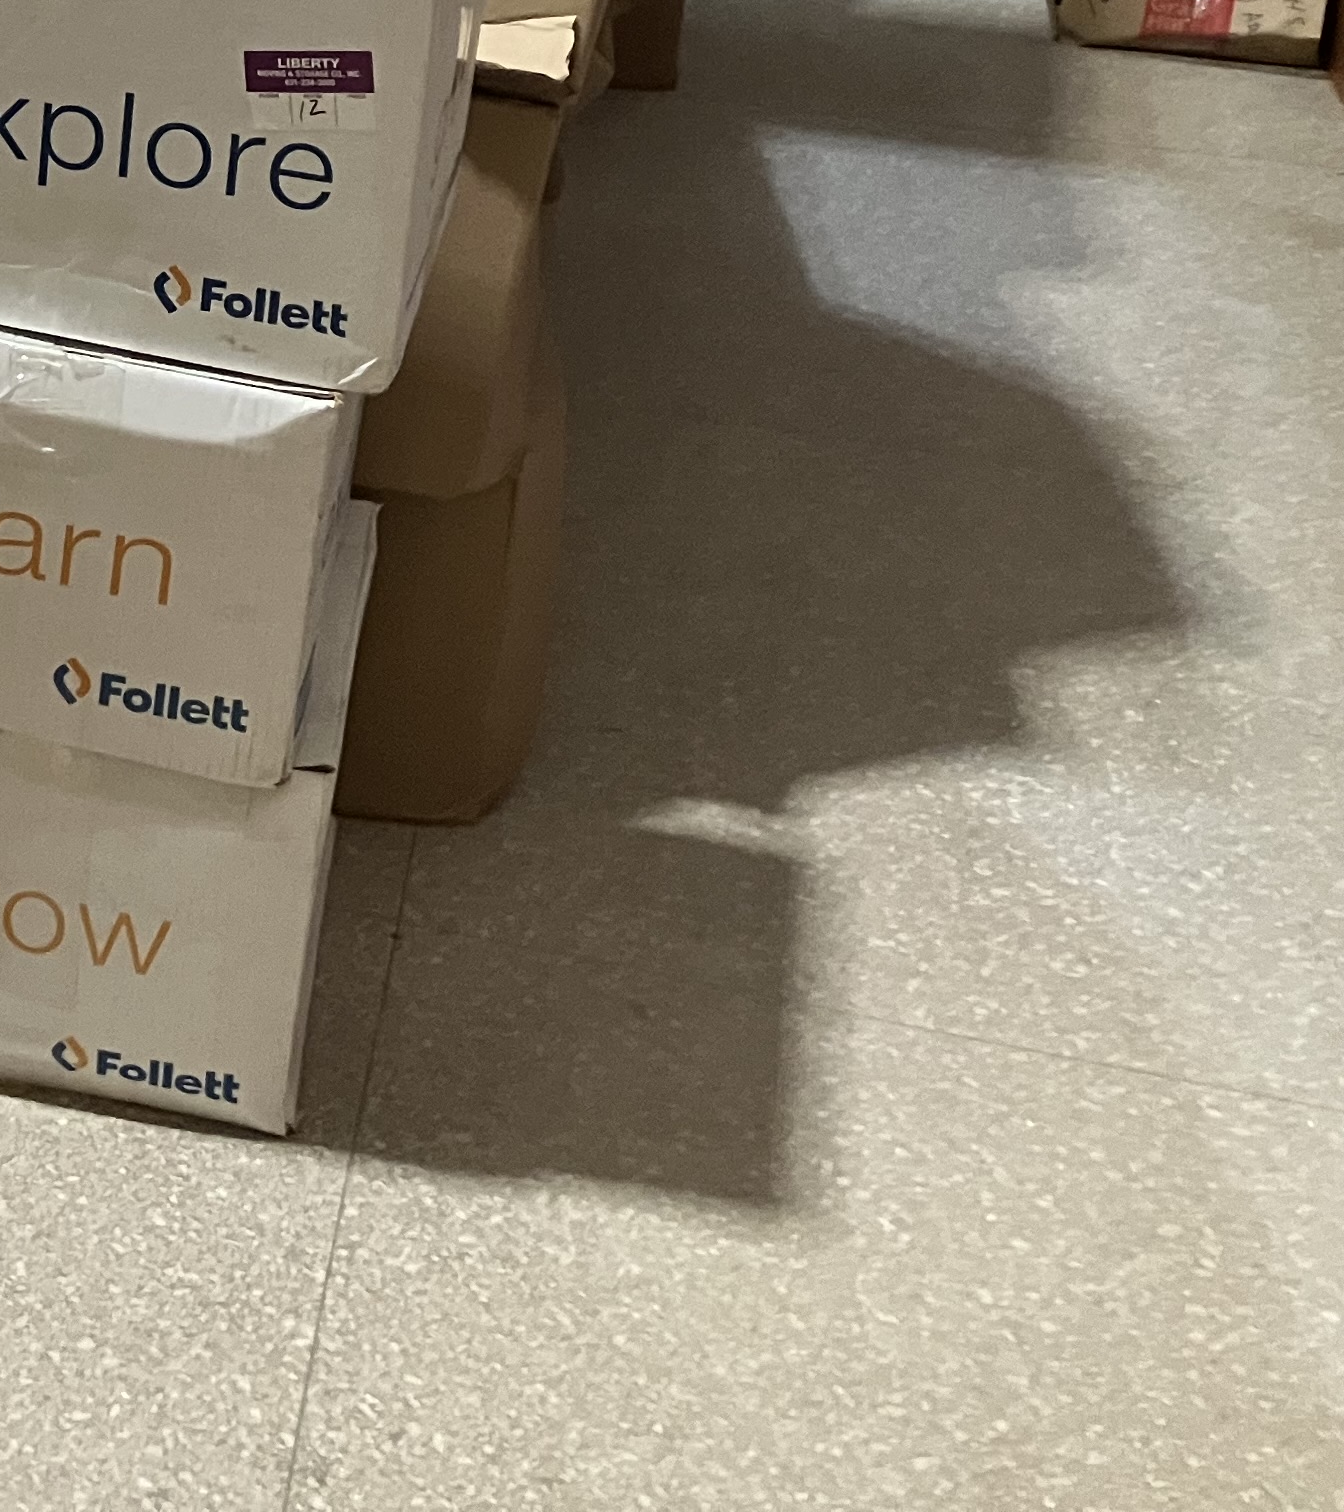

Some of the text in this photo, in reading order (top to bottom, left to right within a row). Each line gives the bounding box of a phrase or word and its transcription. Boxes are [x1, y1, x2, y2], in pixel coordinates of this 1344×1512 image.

[277, 58, 340, 69] LIBERTY
[299, 99, 327, 123] 12
[199, 278, 349, 338] Follett
[98, 672, 249, 733] Follett
[96, 1048, 241, 1104] Follett
